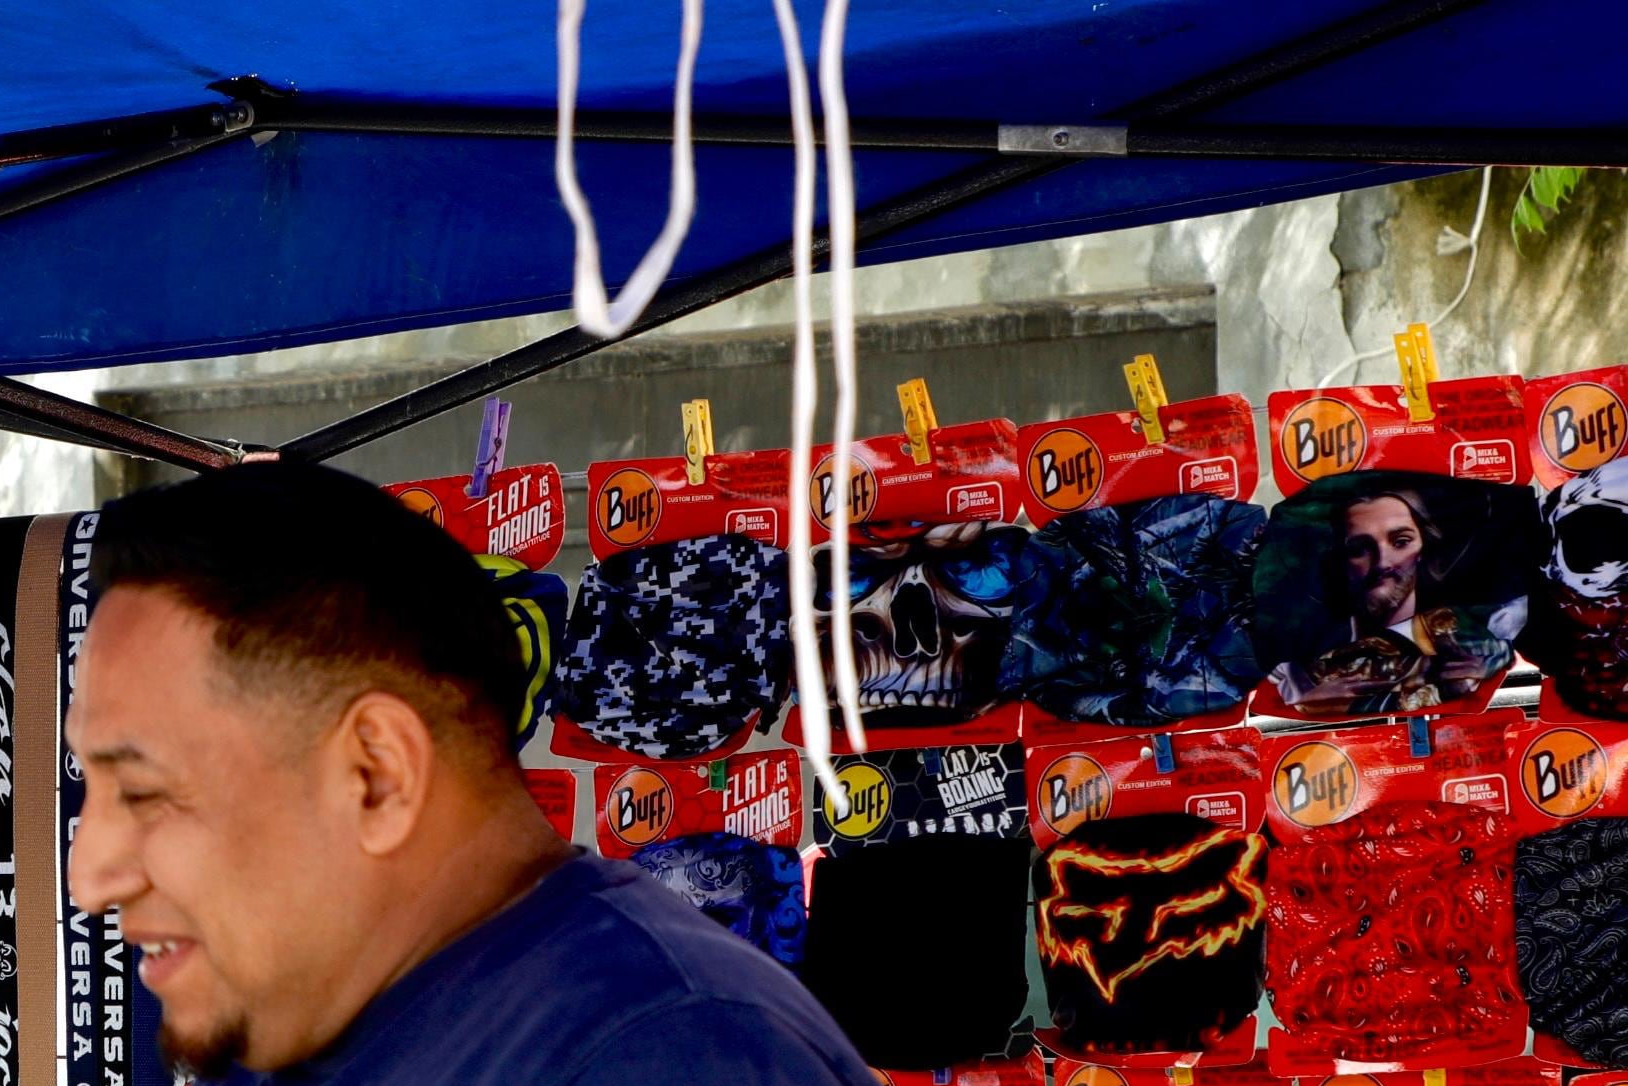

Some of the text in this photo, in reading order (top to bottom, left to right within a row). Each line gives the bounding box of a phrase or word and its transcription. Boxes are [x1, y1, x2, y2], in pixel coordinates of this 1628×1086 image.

[1372, 424, 1435, 437] CUSTOM EDITION
[1290, 417, 1357, 470] Buff
[1108, 447, 1164, 462] CUSTOM EDITION
[1477, 454, 1506, 466] MATCH
[882, 471, 933, 486] CUSTOM EDITION
[1034, 447, 1096, 500] Buff
[1203, 472, 1230, 482] MATCH
[486, 473, 550, 527] FLAT IS
[666, 494, 715, 504] CUSTOM EDITION
[815, 471, 870, 521] Bff
[969, 497, 995, 508] MATCH
[604, 486, 654, 533] Buff
[746, 522, 770, 532] MATCH
[937, 749, 991, 782] LAT IS
[1363, 764, 1425, 778] CUSTOM EDITION
[722, 758, 788, 812] FLAT IS
[1117, 779, 1172, 790] CUSTOM EDITION
[1281, 761, 1349, 815] Buff
[1469, 790, 1499, 801] MATCH
[614, 785, 667, 833] Buff
[1210, 807, 1237, 817] MATCH
